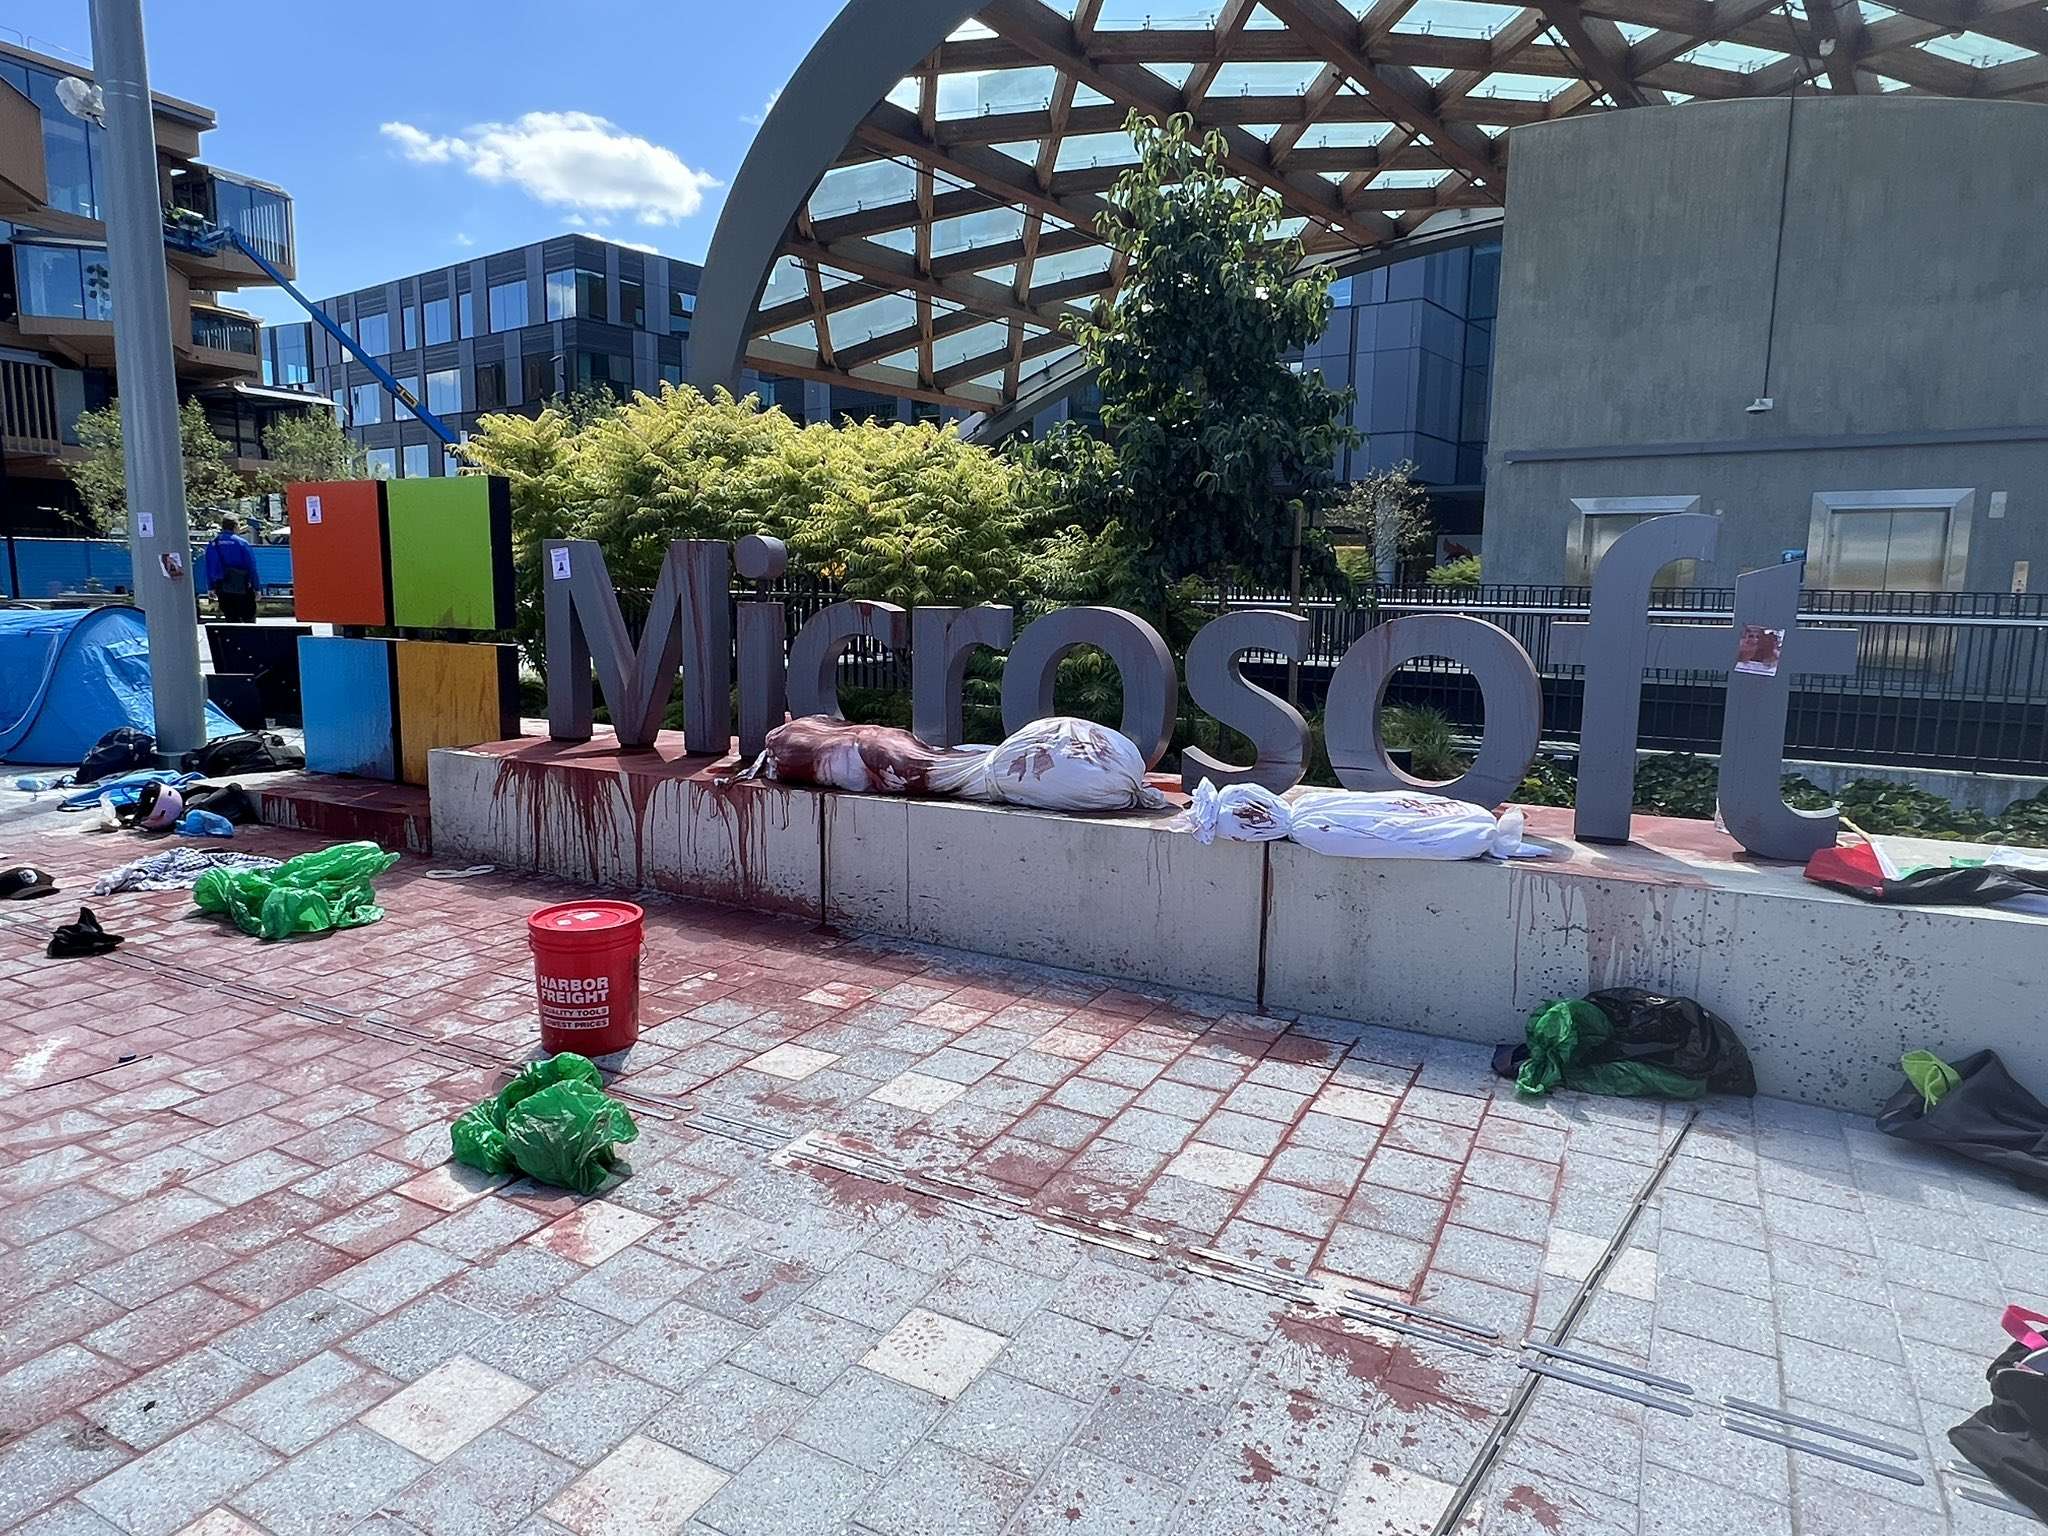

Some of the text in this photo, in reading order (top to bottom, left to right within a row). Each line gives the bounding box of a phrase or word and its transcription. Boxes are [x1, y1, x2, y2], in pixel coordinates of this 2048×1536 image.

[542, 512, 1858, 861] Microsoft
[540, 975, 608, 991] HARBOR
[541, 987, 609, 1004] FREIGHT
[577, 1007, 607, 1016] TOOLS
[574, 1020, 607, 1028] PRICES
